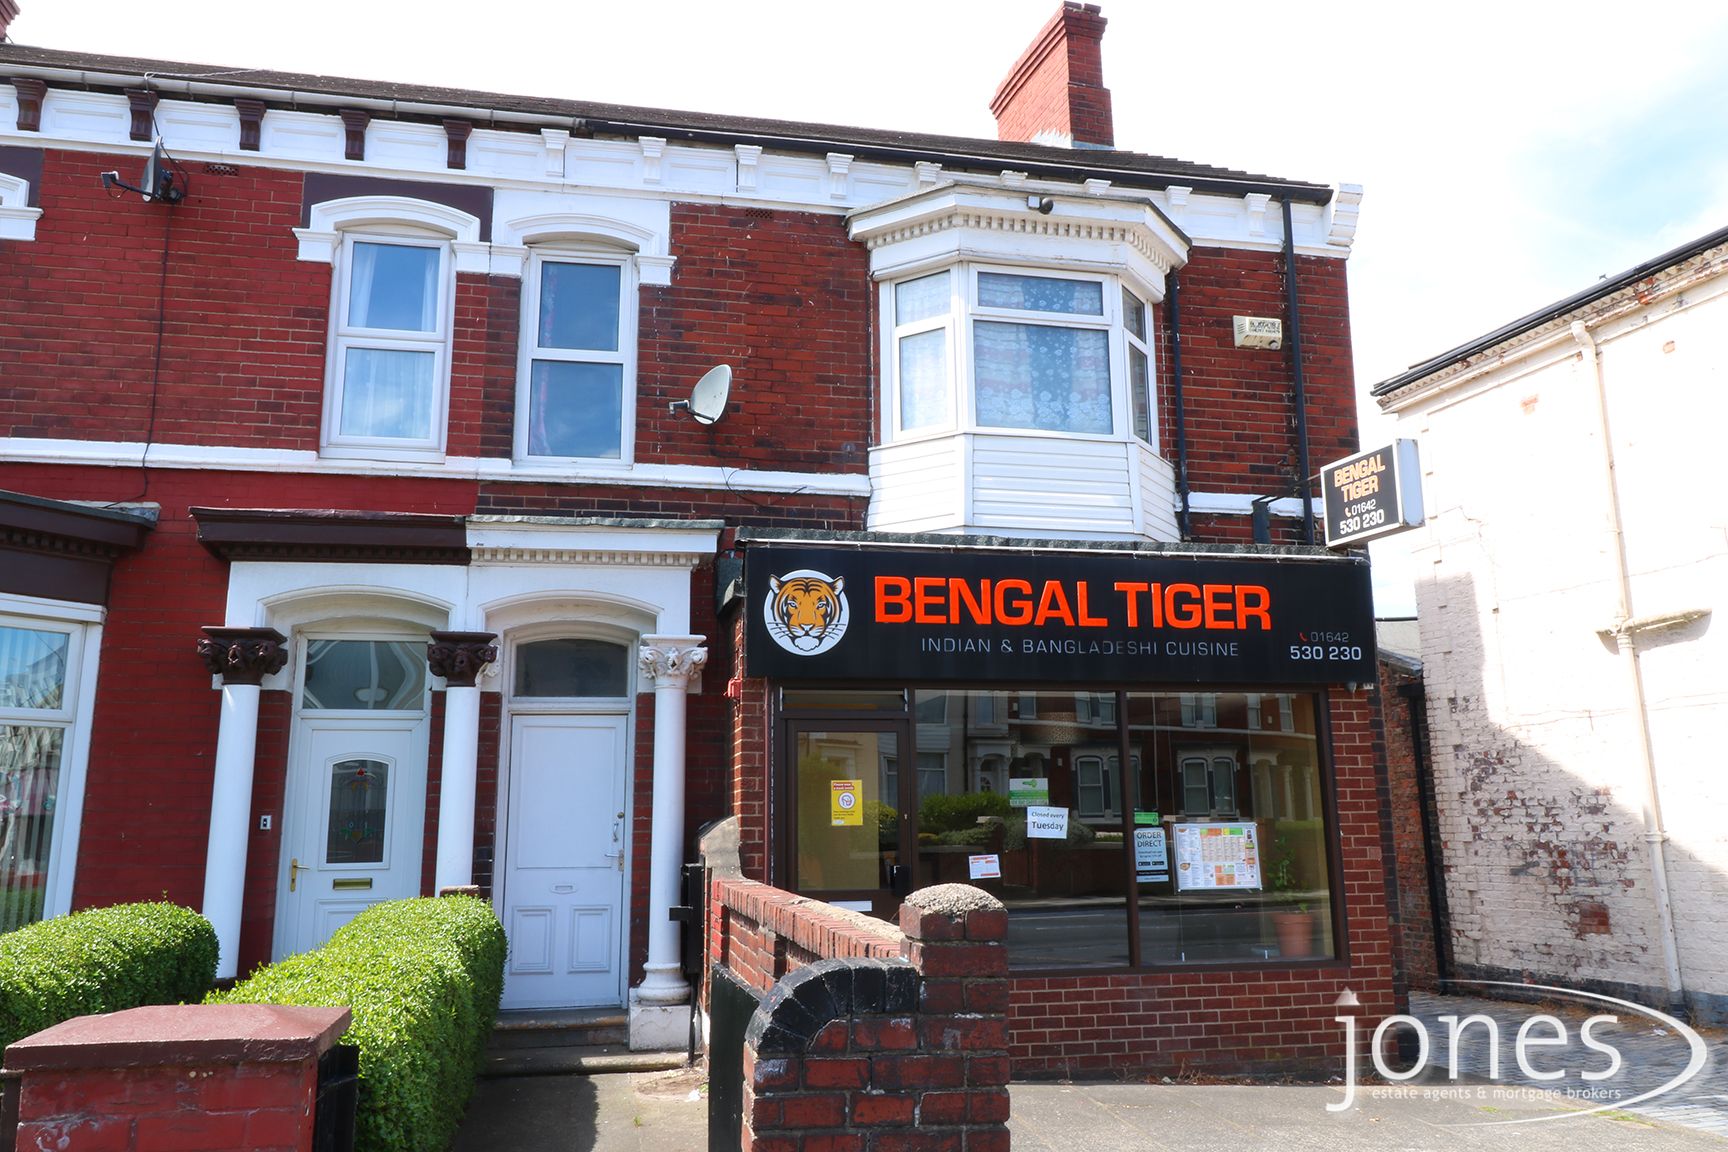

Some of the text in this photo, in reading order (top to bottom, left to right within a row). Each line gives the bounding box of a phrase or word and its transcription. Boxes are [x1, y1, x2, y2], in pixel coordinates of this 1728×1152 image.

[1334, 454, 1385, 487] BENGAL
[1341, 475, 1379, 502] TIGER
[1352, 499, 1376, 515] 01642
[1340, 510, 1384, 534] 530 230
[874, 575, 1272, 630] BENGAL TIGER
[1310, 632, 1349, 643] 01642
[921, 638, 1239, 656] INDIAN & BANGLADESHI CUISINE
[1290, 645, 1362, 661] 530 230
[1031, 821, 1065, 832] Tuesday
[1136, 831, 1162, 839] ORDER
[1137, 839, 1162, 848] DIRECT
